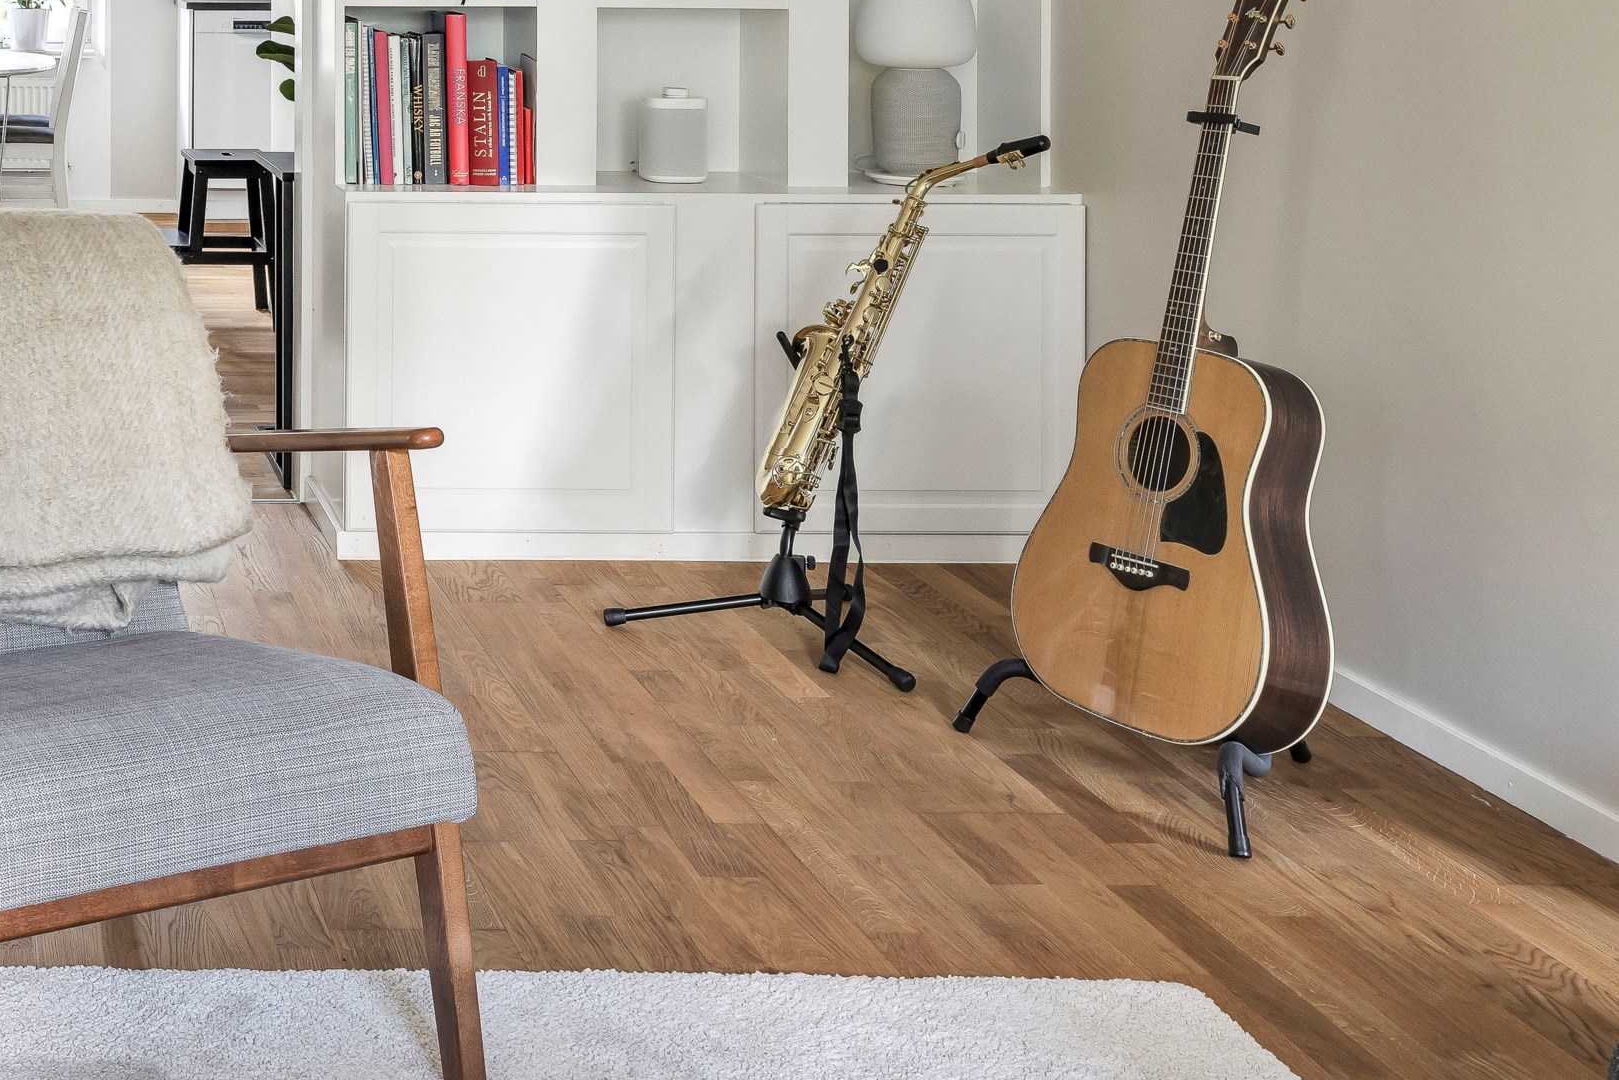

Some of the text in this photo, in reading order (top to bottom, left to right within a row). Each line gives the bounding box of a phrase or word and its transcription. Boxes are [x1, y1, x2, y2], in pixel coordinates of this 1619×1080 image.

[413, 84, 423, 133] WHISKY
[455, 68, 466, 125] FRANSKA
[429, 114, 441, 126] JAG
[429, 128, 442, 137] ÄR
[472, 91, 487, 157] STALIN
[430, 138, 441, 166] FOTBOLL
